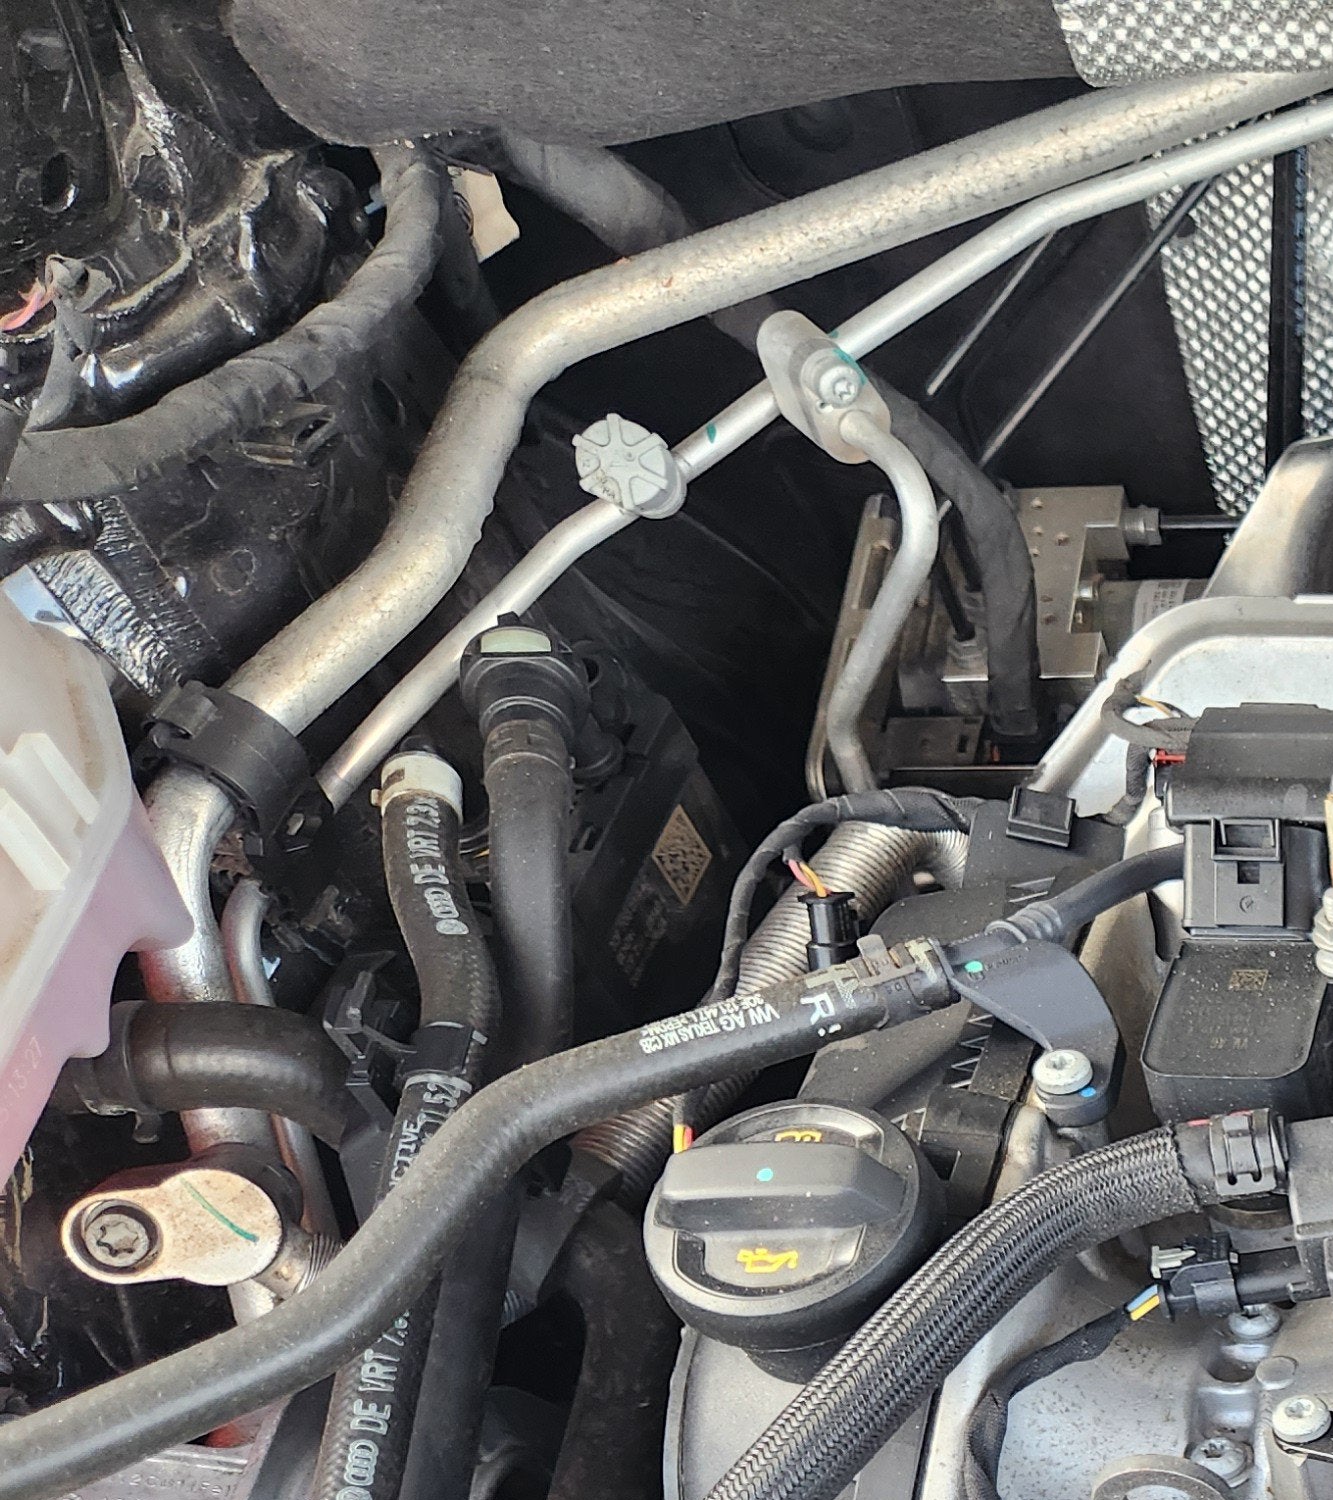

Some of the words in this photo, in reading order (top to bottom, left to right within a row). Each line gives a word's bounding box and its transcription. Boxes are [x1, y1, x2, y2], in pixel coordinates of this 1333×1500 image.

[406, 829, 441, 858] VRT
[409, 863, 449, 885] DE
[721, 1012, 746, 1031] AG
[751, 1003, 780, 1026] VW
[663, 1031, 682, 1048] MX
[681, 1018, 721, 1042] TEKLAS
[358, 1348, 400, 1391] VRT
[350, 1399, 392, 1435] DE
